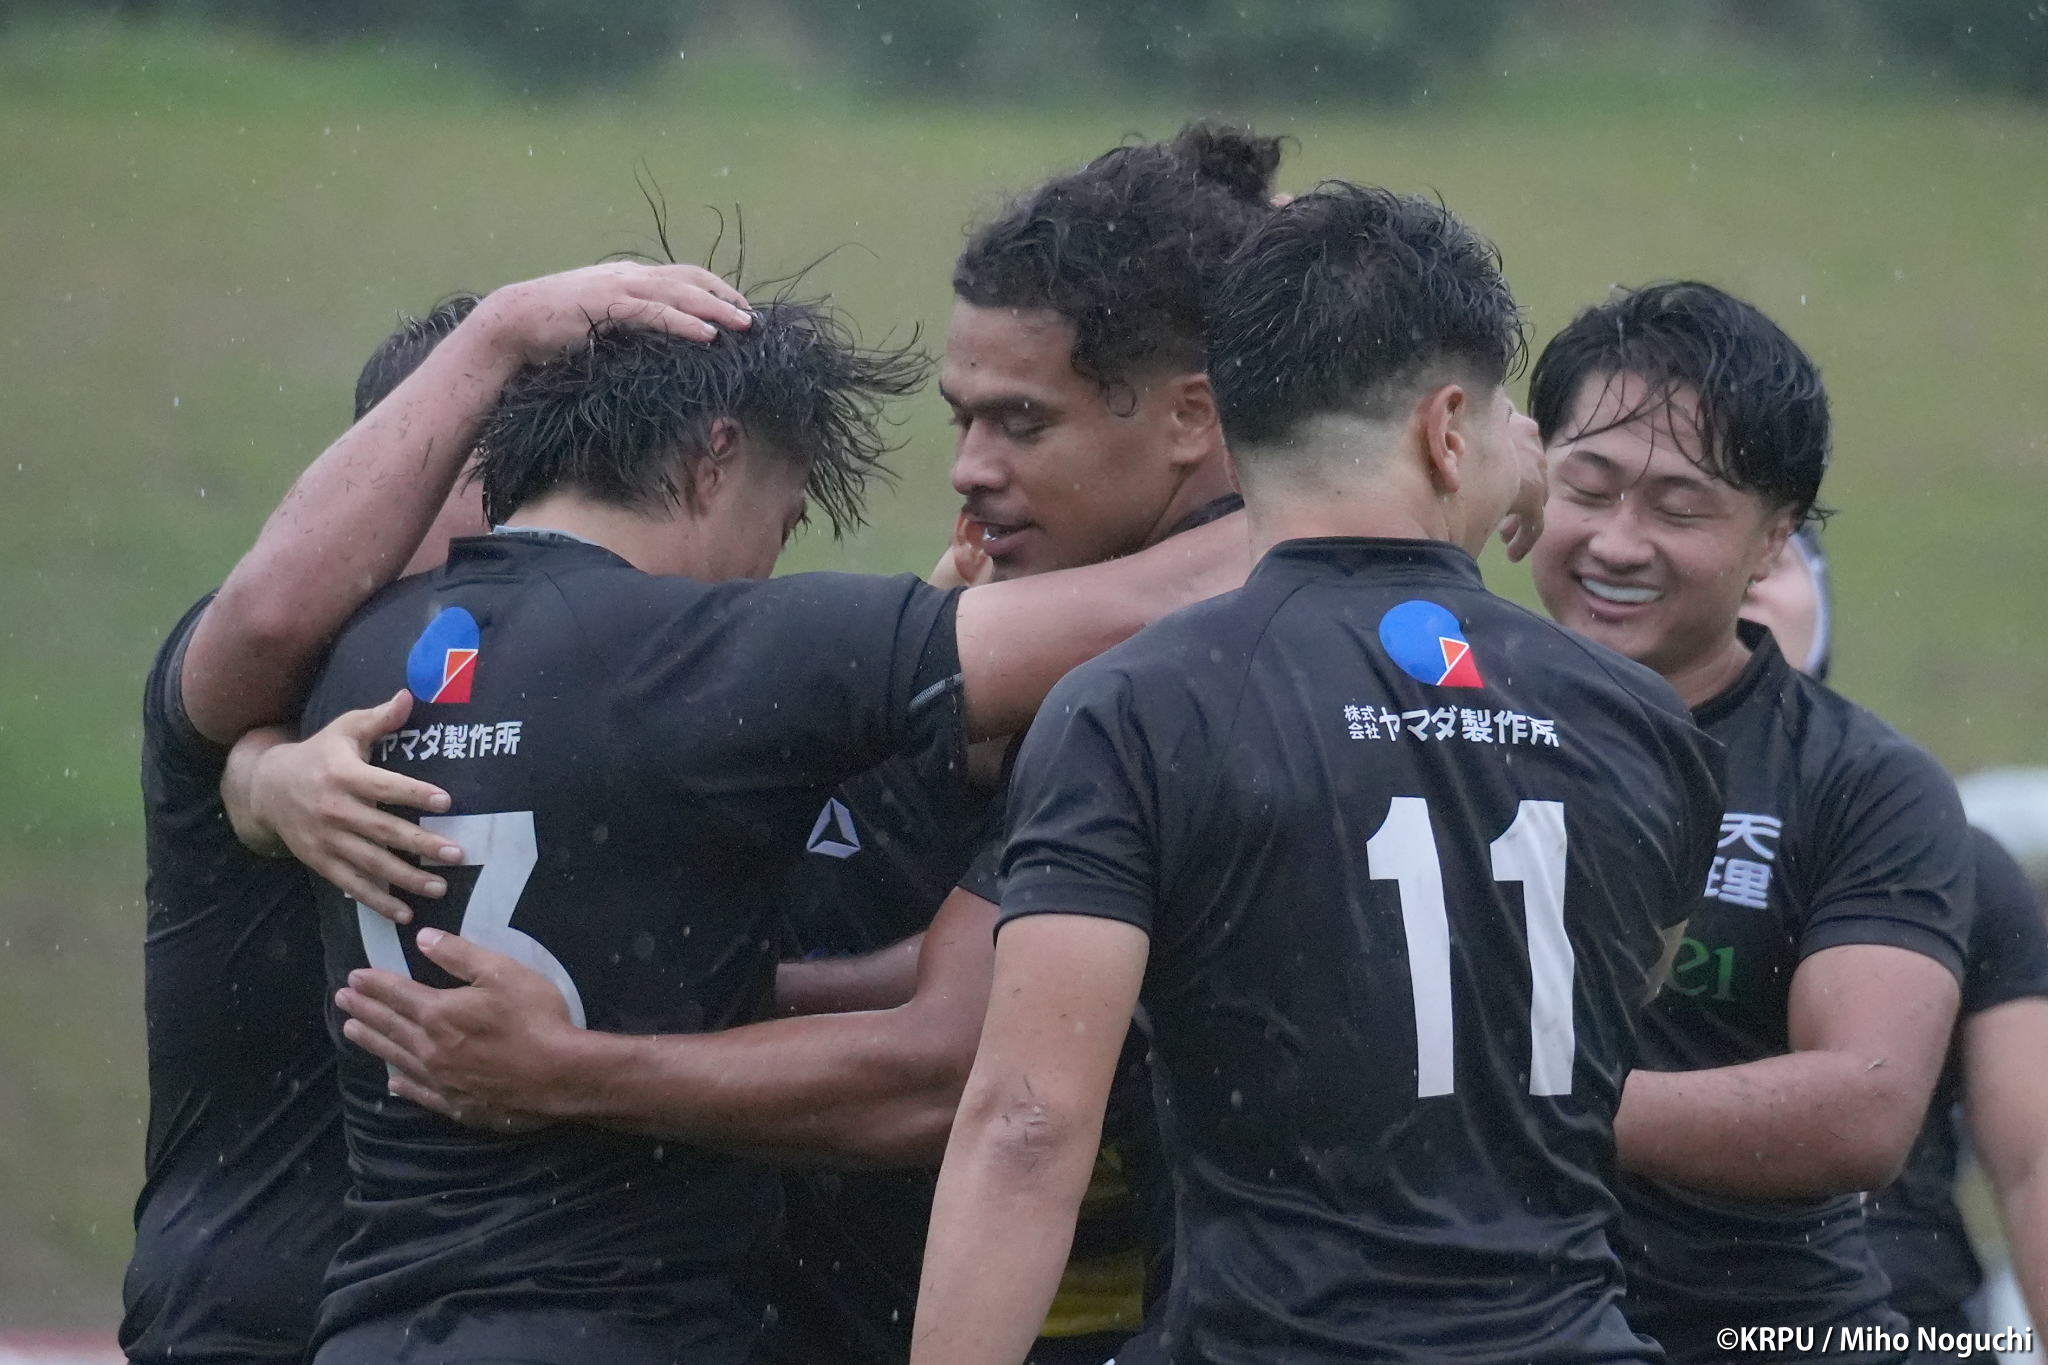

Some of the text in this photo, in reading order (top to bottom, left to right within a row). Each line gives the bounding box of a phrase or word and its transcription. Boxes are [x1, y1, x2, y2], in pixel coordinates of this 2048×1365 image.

[1343, 704, 1377, 722] 株式
[1379, 704, 1560, 748] ヤマダ製作所
[1347, 722, 1381, 740] 会社
[1366, 796, 1575, 1098] 11
